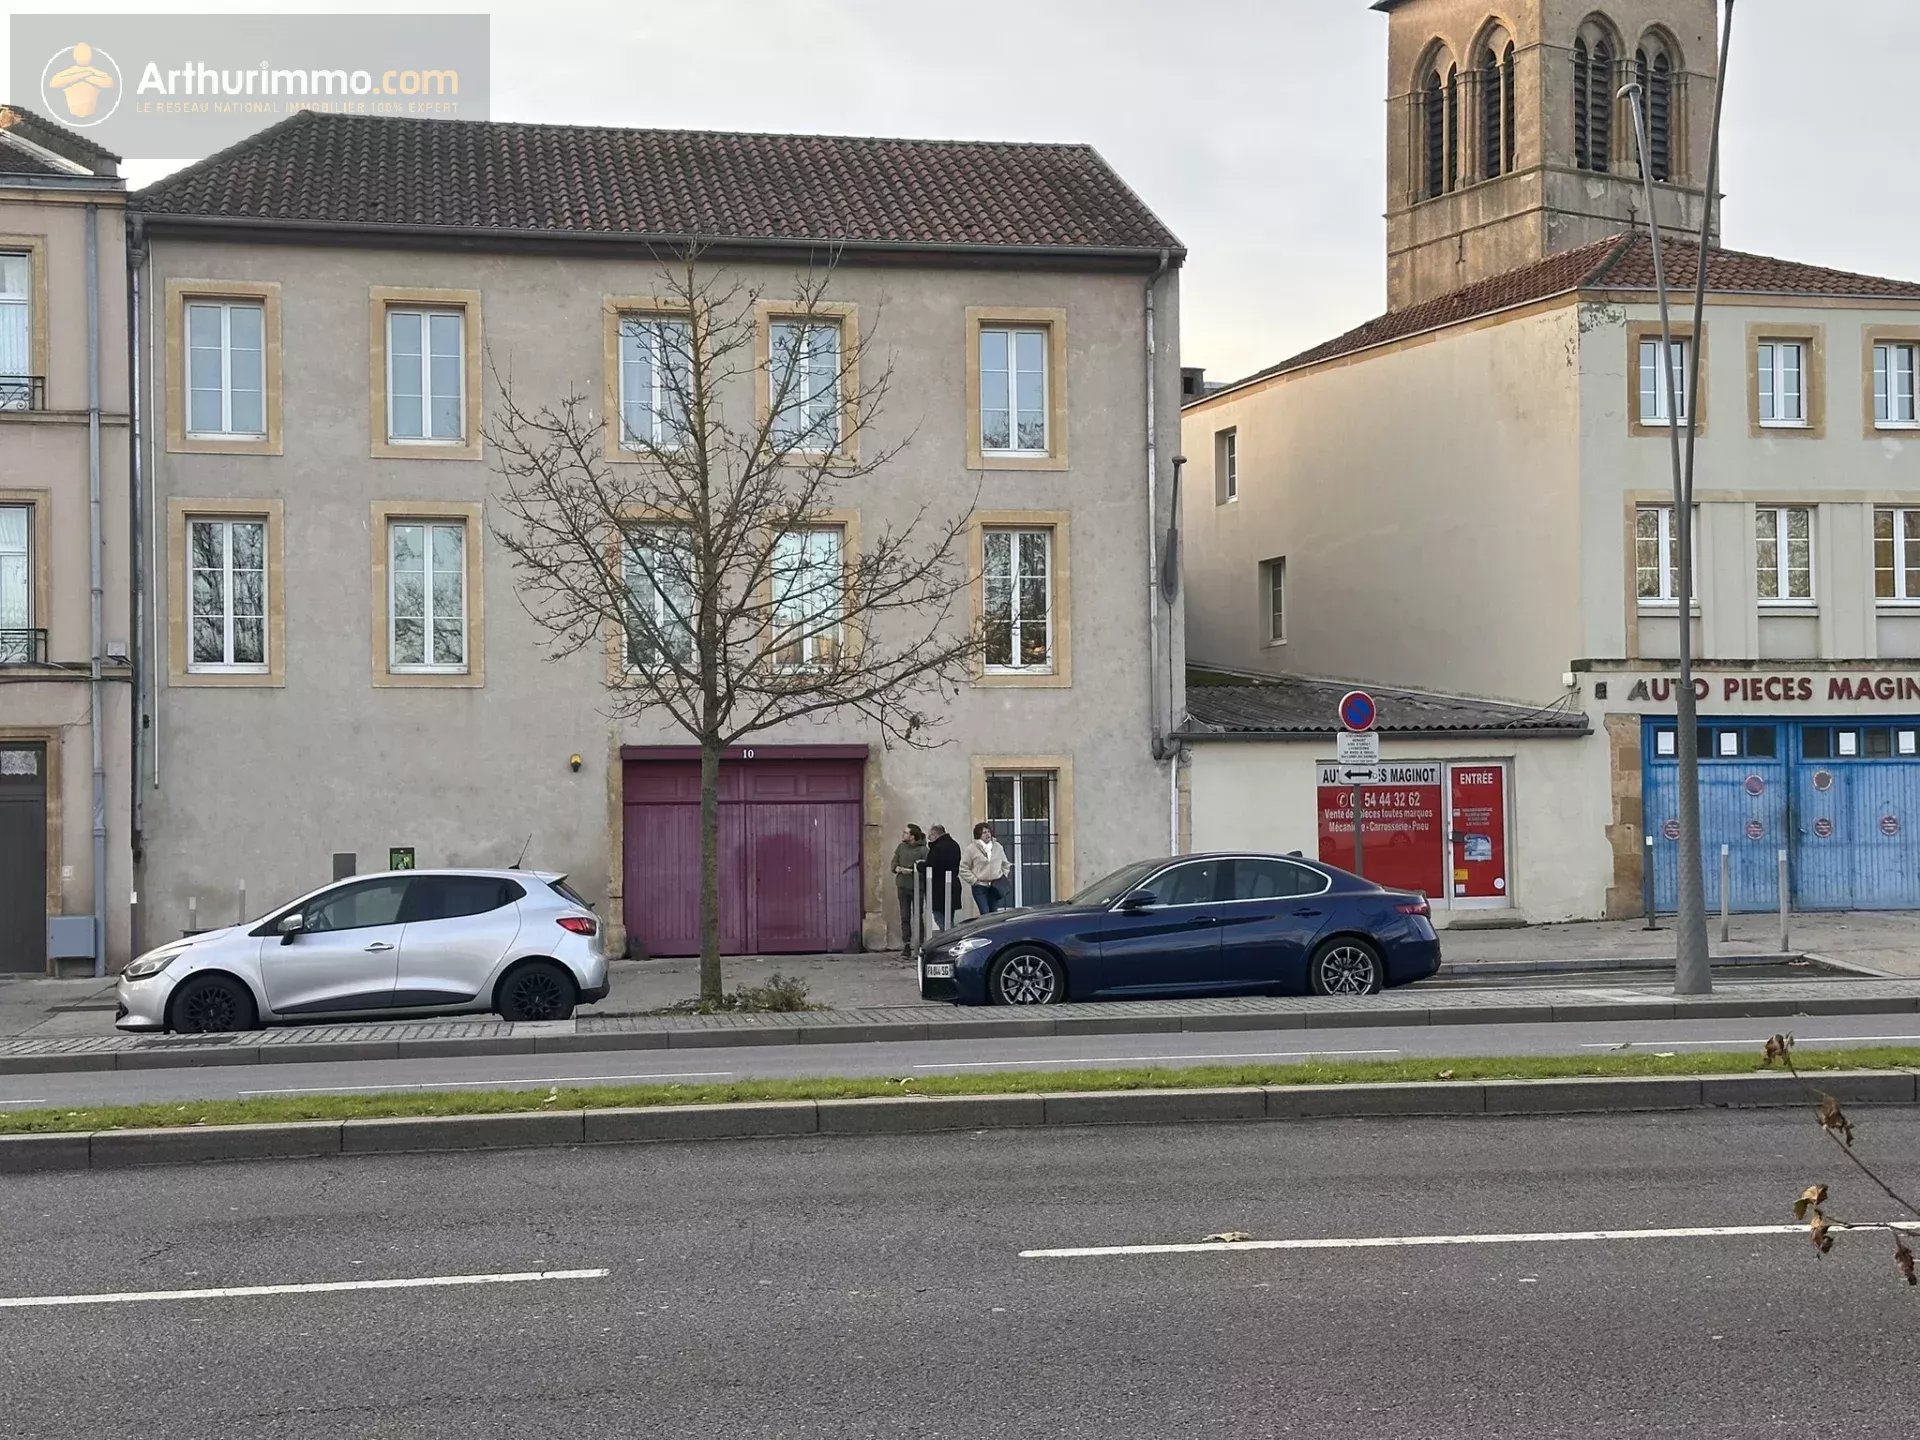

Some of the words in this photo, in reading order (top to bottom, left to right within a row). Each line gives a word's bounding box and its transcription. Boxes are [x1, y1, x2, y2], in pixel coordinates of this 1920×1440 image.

[1724, 677, 1813, 701] PIECES
[743, 749, 754, 759] 10
[1390, 768, 1435, 783] MAGINOT
[1460, 770, 1493, 785] ENTRÉE
[1364, 792, 1377, 807] 54
[1378, 792, 1391, 807] 44
[1394, 792, 1405, 807] 32
[1408, 791, 1420, 807] 62
[1324, 808, 1345, 819] Vente
[1345, 808, 1354, 819] de
[1381, 808, 1403, 819] toutes
[1404, 808, 1433, 820] marques
[1369, 821, 1408, 832] Carrosserie
[1412, 820, 1429, 831] Pneu
